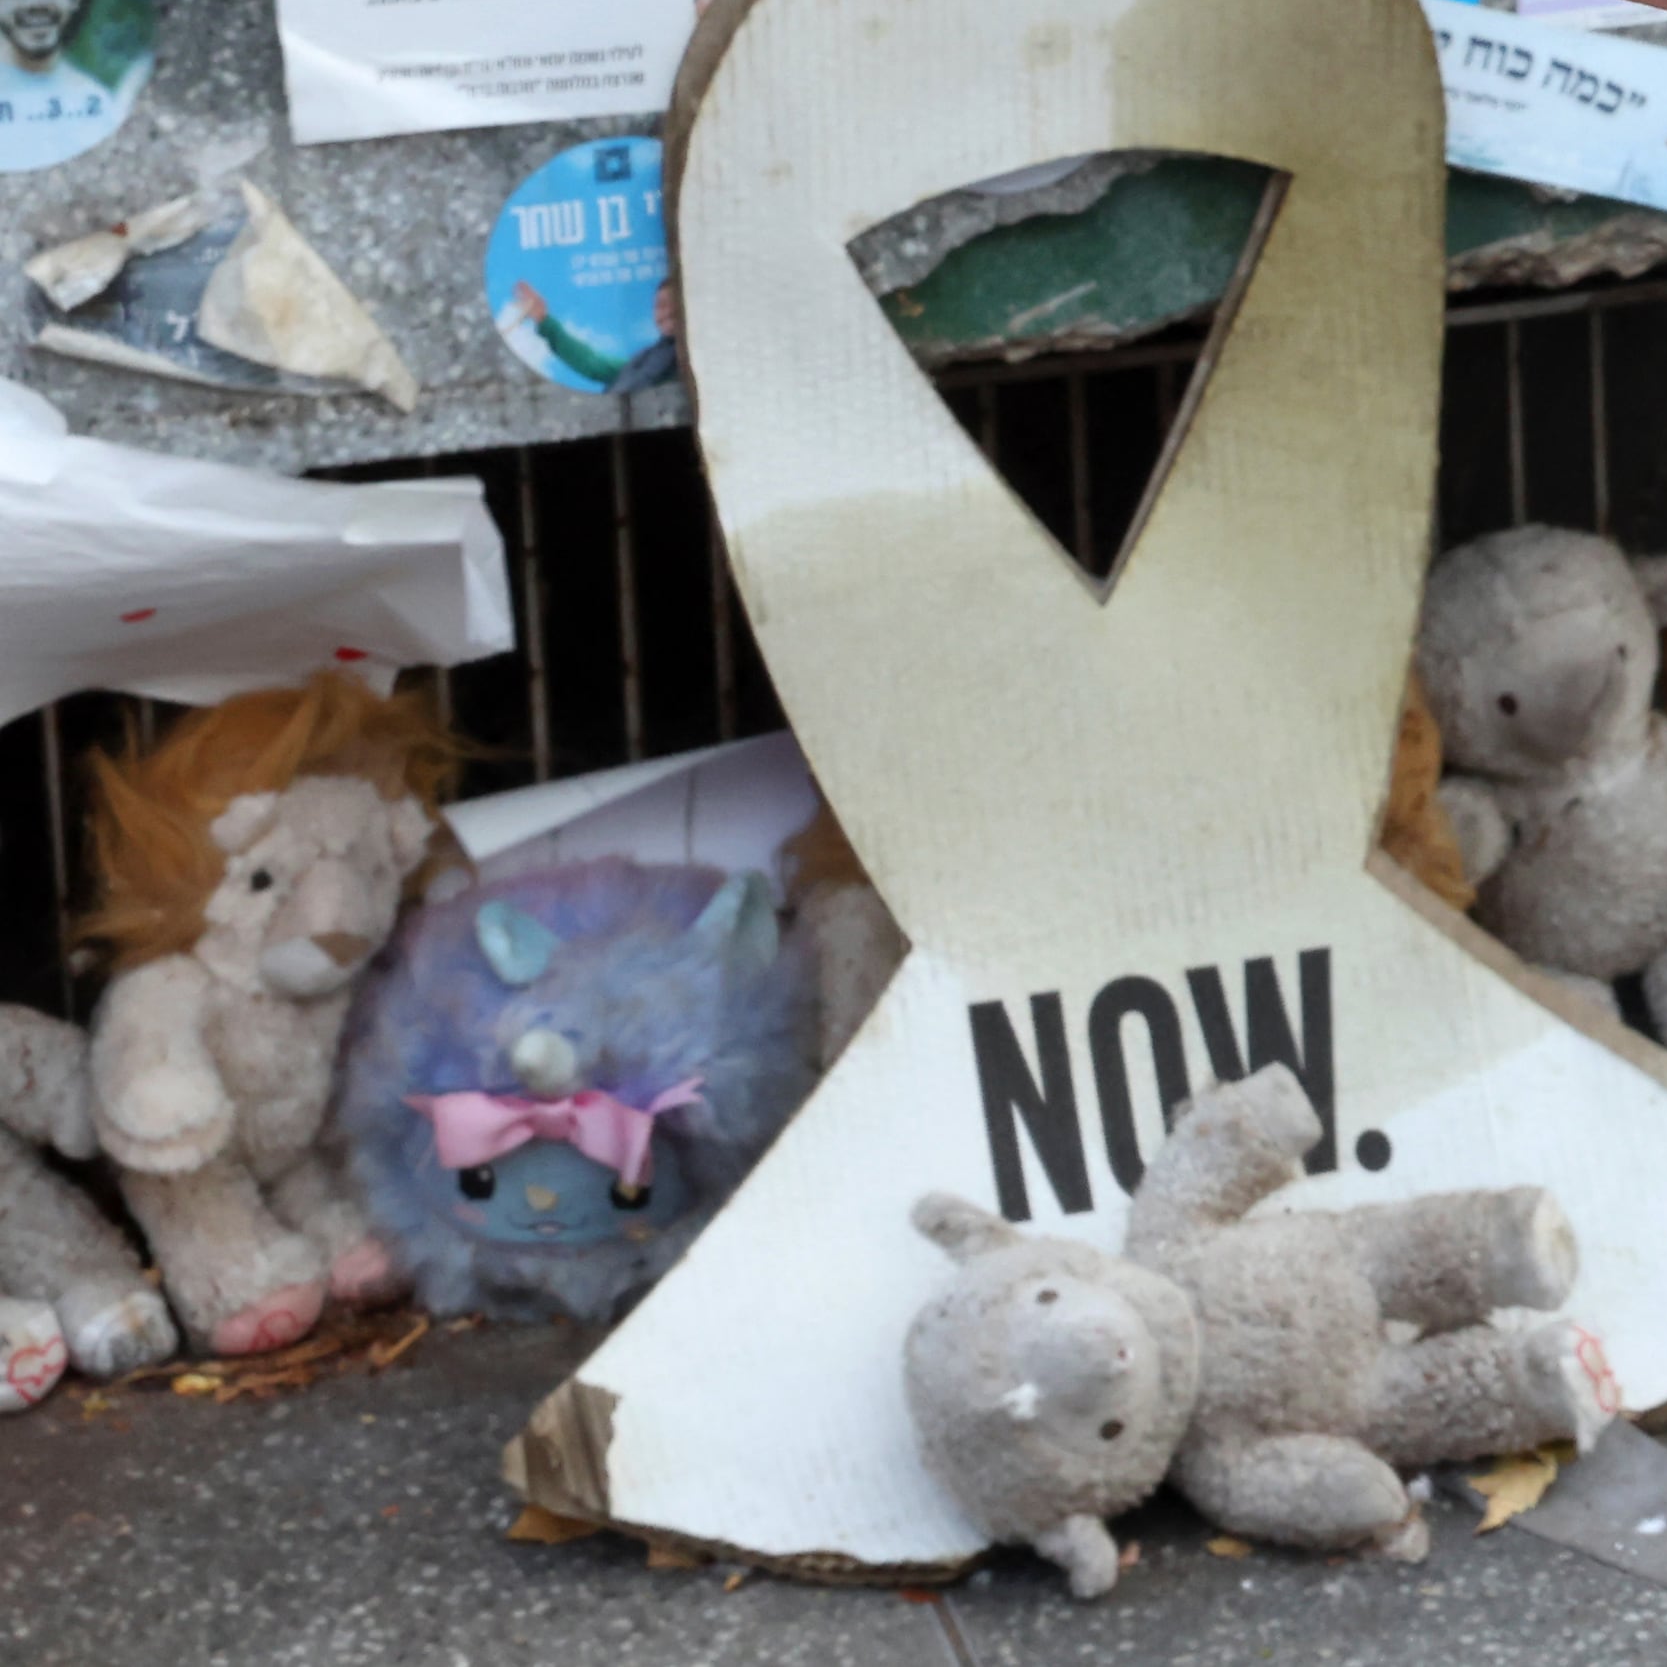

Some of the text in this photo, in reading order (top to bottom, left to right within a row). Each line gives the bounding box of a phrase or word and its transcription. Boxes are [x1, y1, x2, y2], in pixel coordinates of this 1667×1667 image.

[1464, 35, 1535, 81] כוח
[510, 197, 585, 251] שחר
[597, 193, 632, 245] בן
[968, 945, 1391, 1222] NOW.
